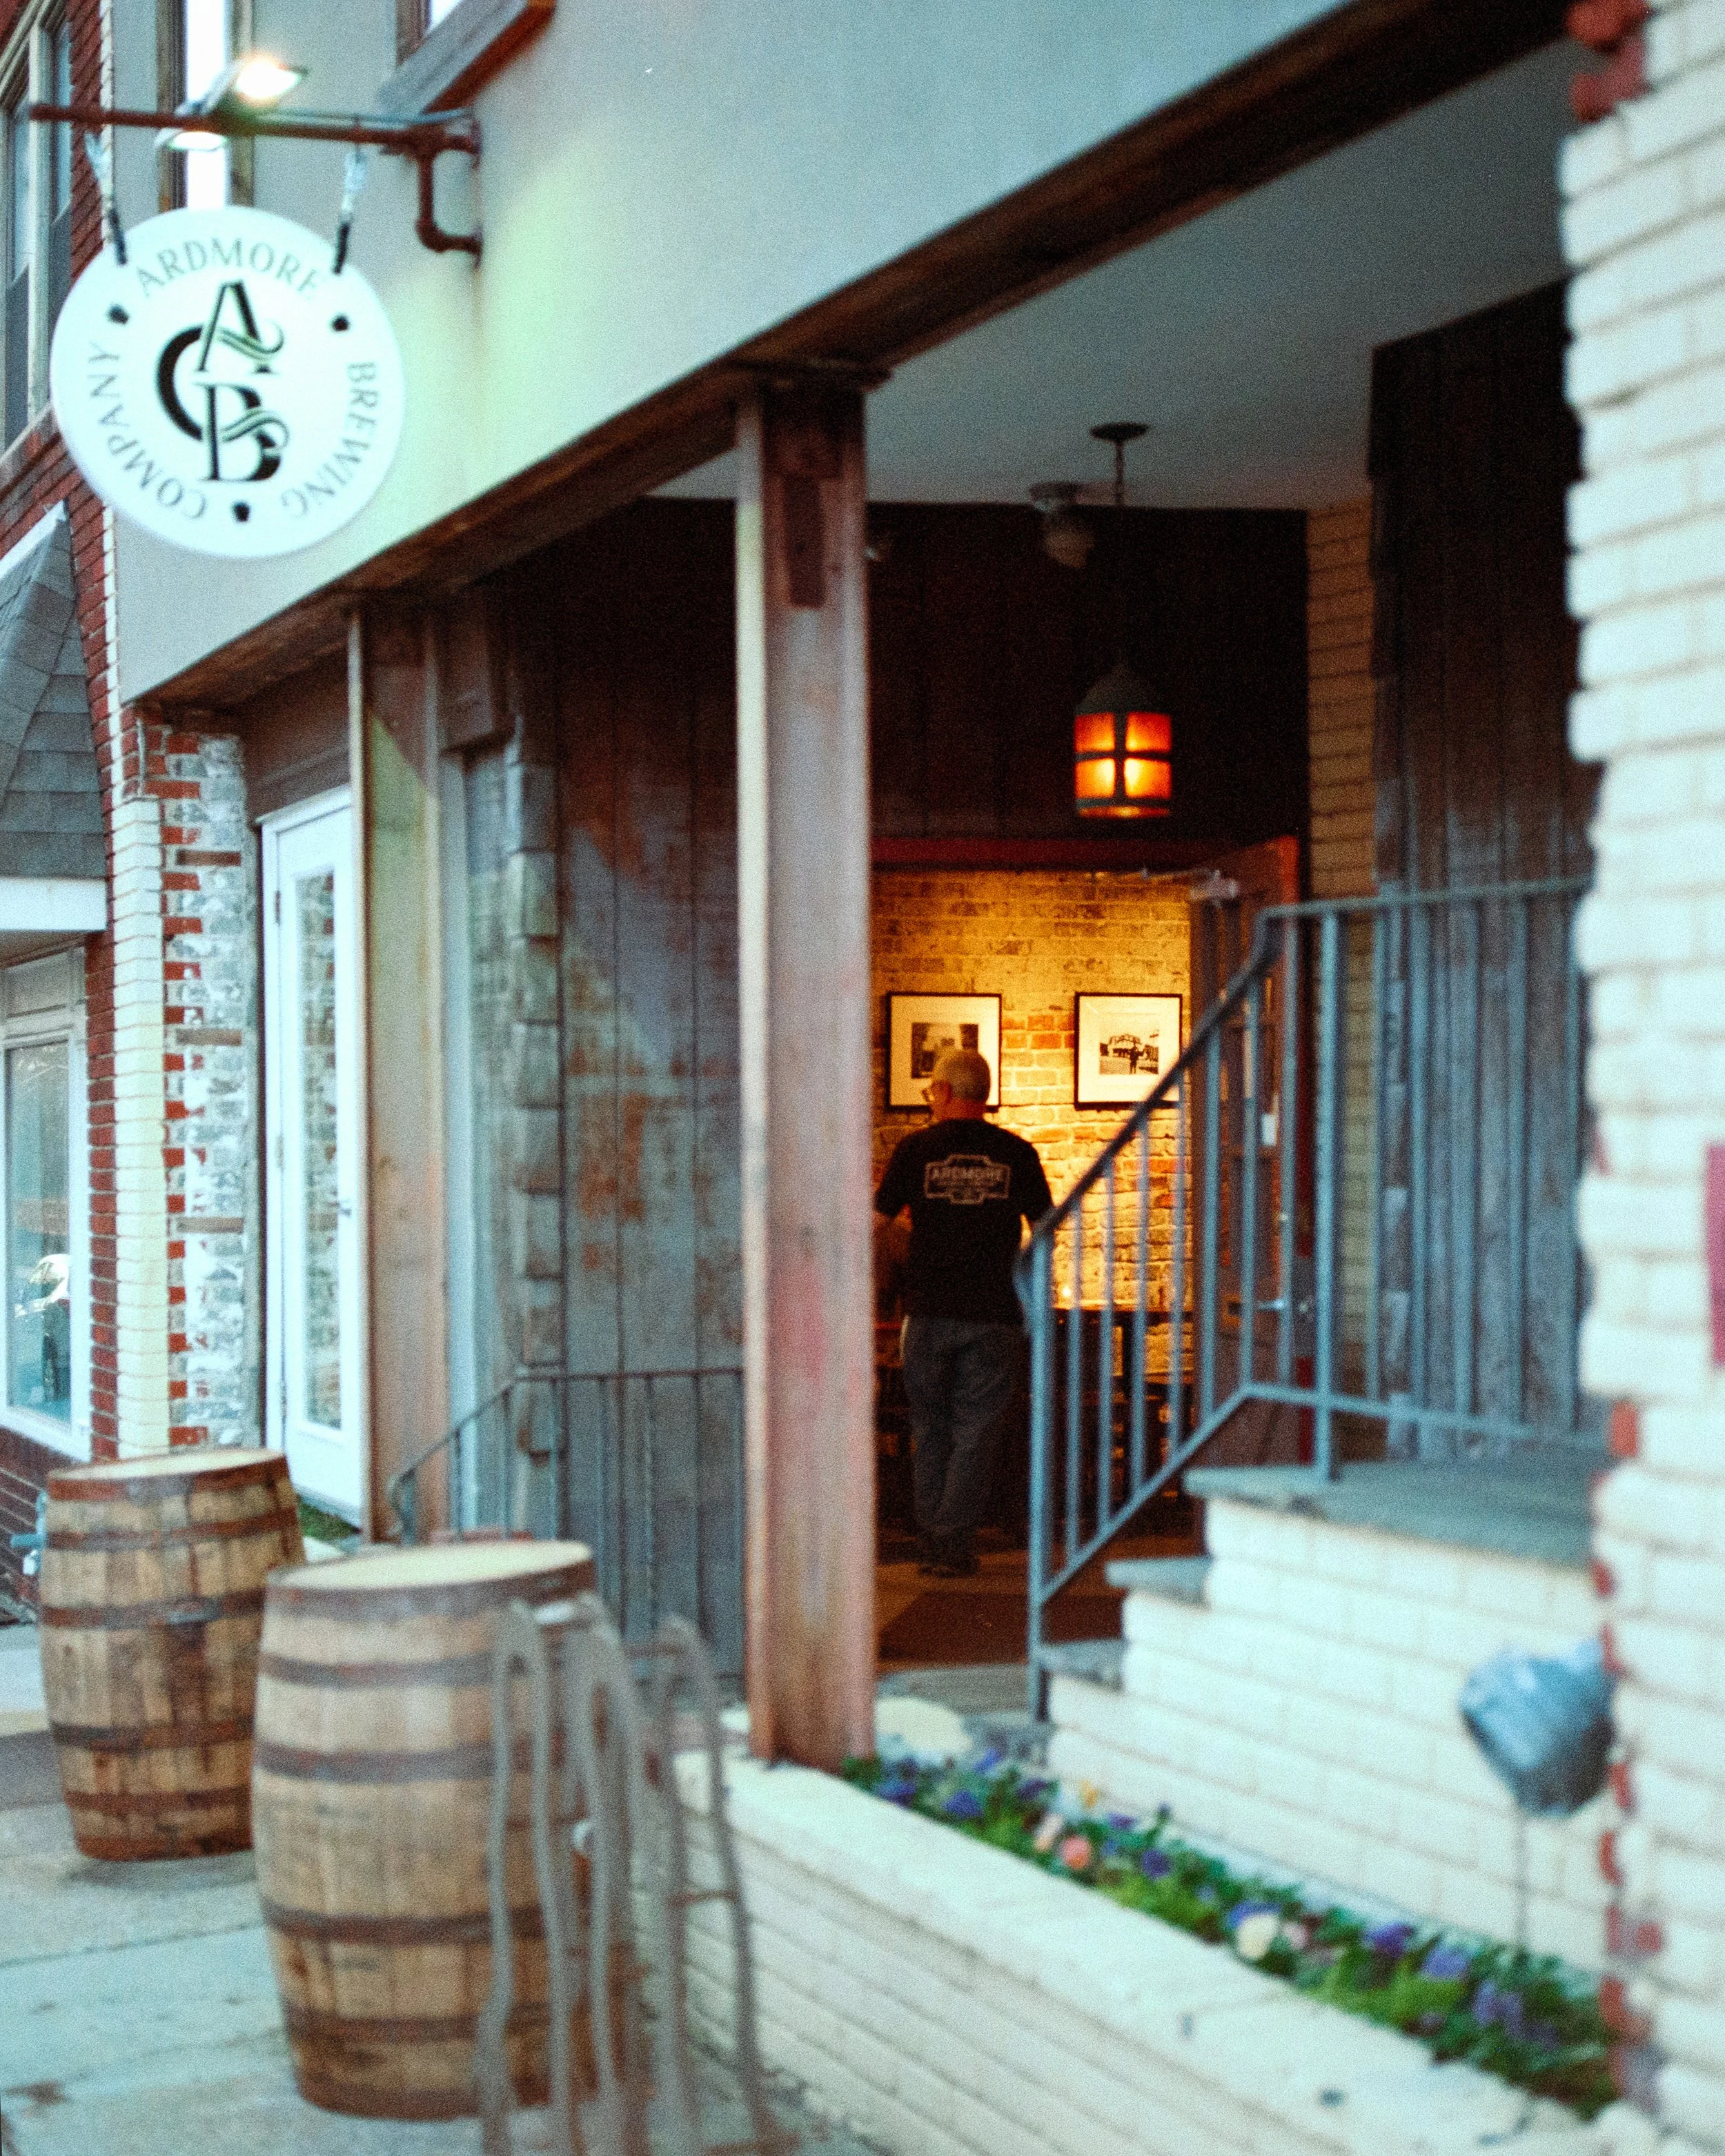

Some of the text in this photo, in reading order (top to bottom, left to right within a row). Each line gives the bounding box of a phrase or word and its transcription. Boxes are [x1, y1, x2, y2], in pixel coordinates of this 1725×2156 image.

[136, 237, 326, 299] ARDMORE
[88, 342, 207, 519] COMPANY
[281, 362, 379, 517] BREWING
